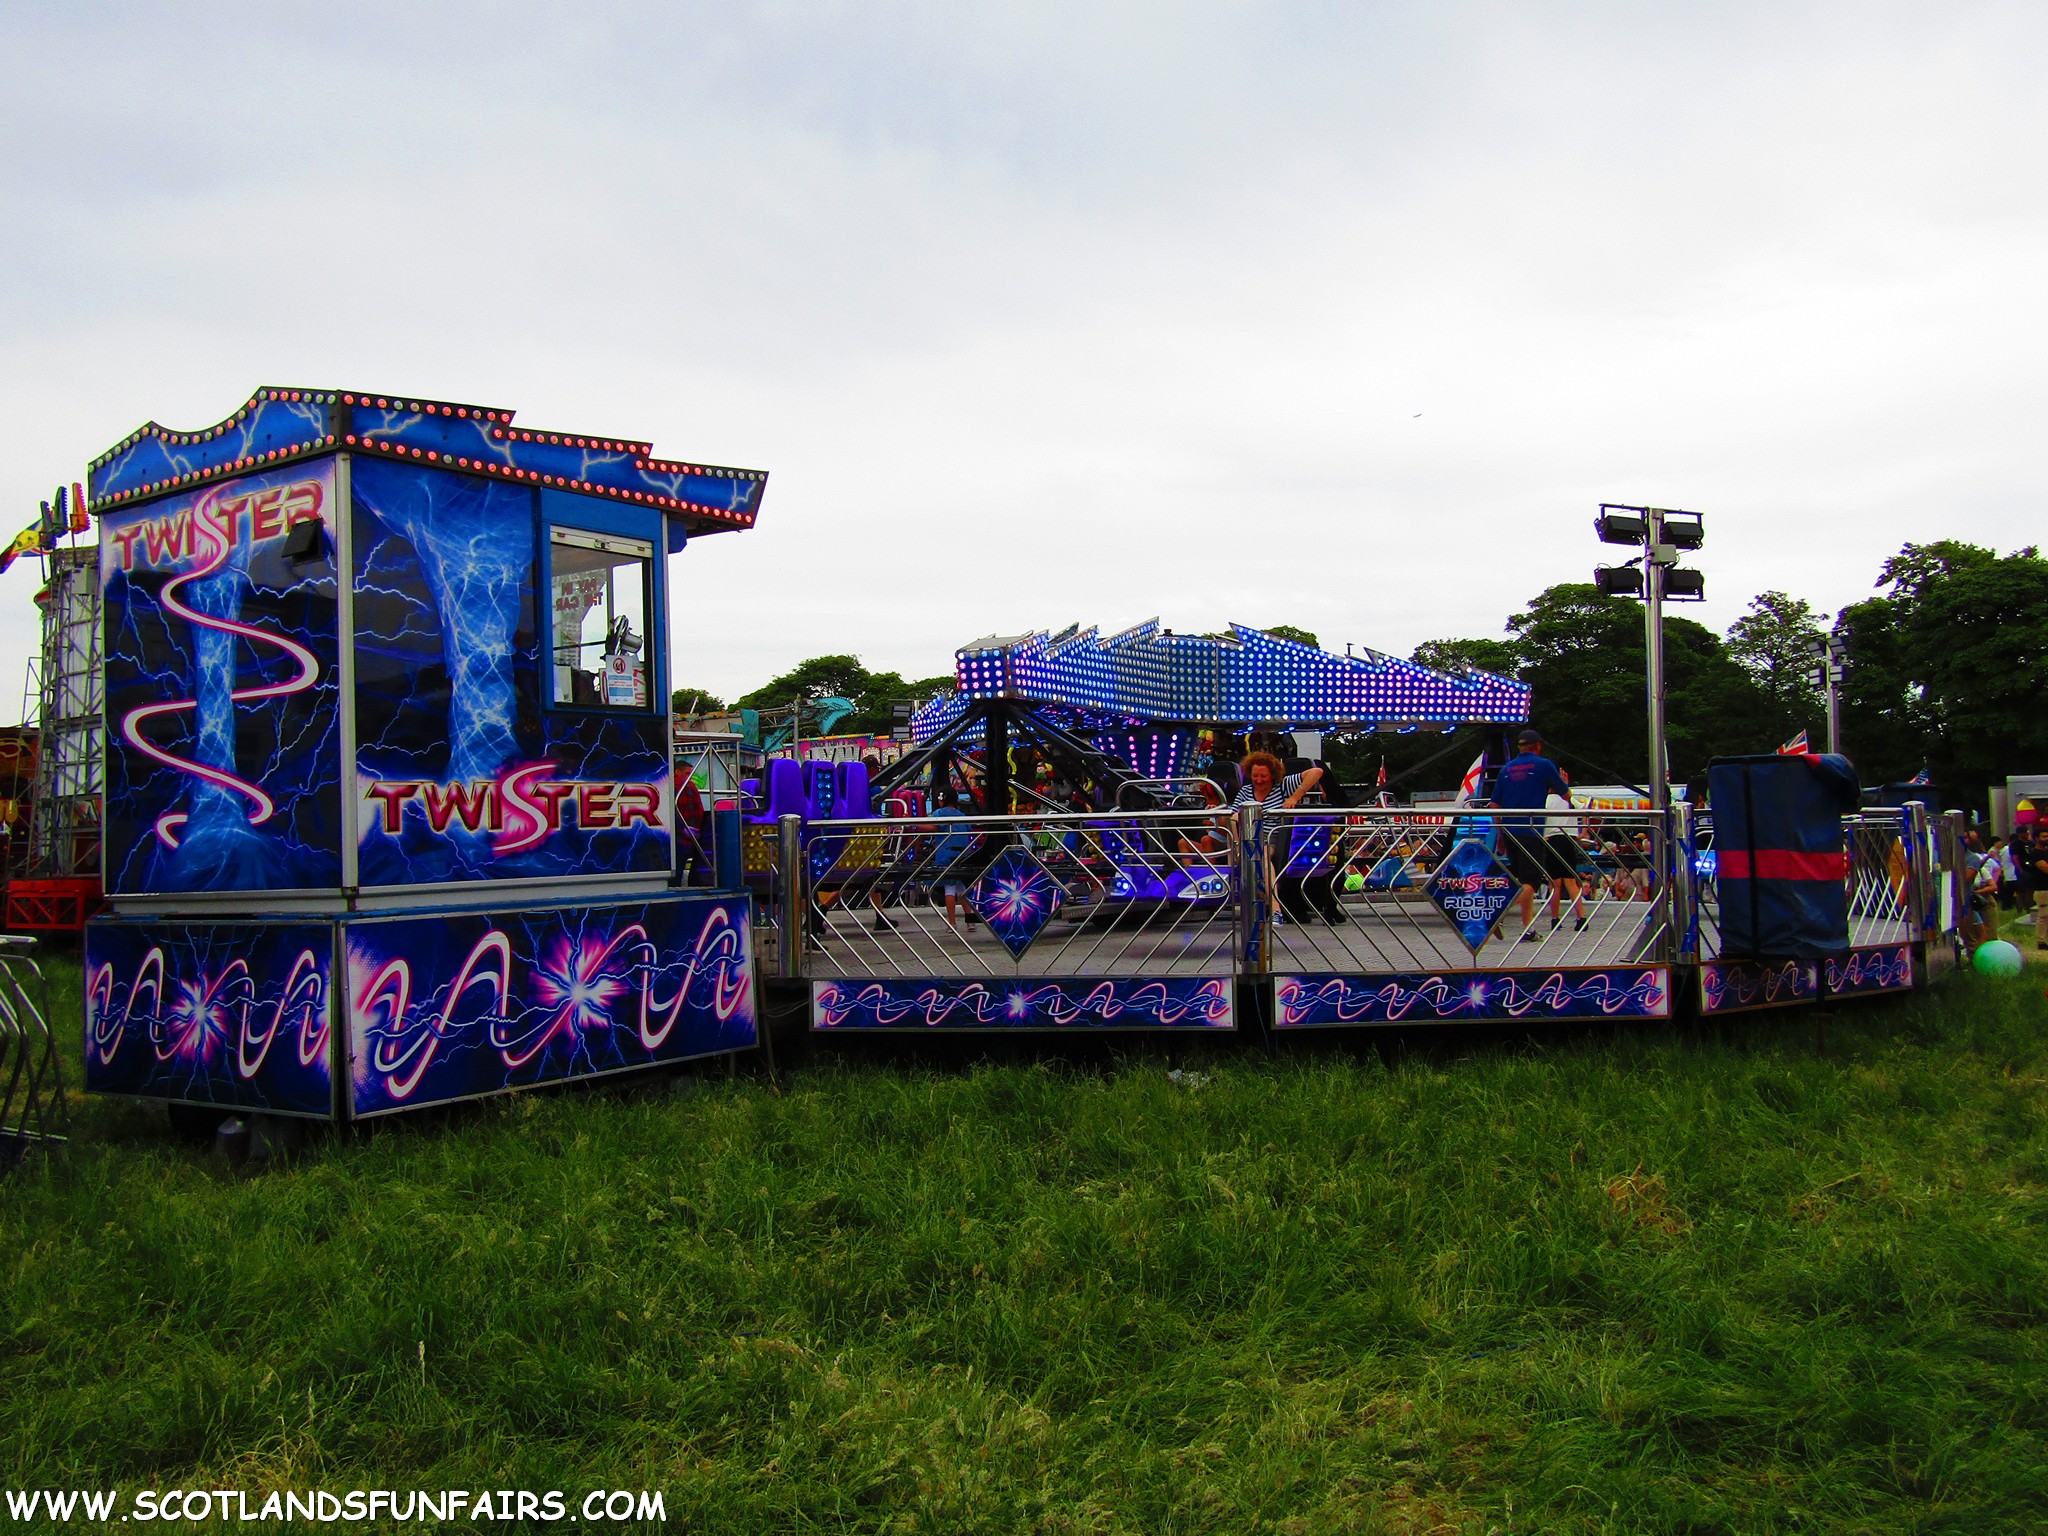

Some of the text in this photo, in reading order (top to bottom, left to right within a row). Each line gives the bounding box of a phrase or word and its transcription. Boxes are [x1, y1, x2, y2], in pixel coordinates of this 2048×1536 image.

[111, 479, 327, 576] TWISTER
[364, 763, 665, 851] TWISTER
[1438, 873, 1509, 893] TWISTER
[1444, 896, 1506, 909] RIDE IT
[1456, 909, 1495, 921] OUT
